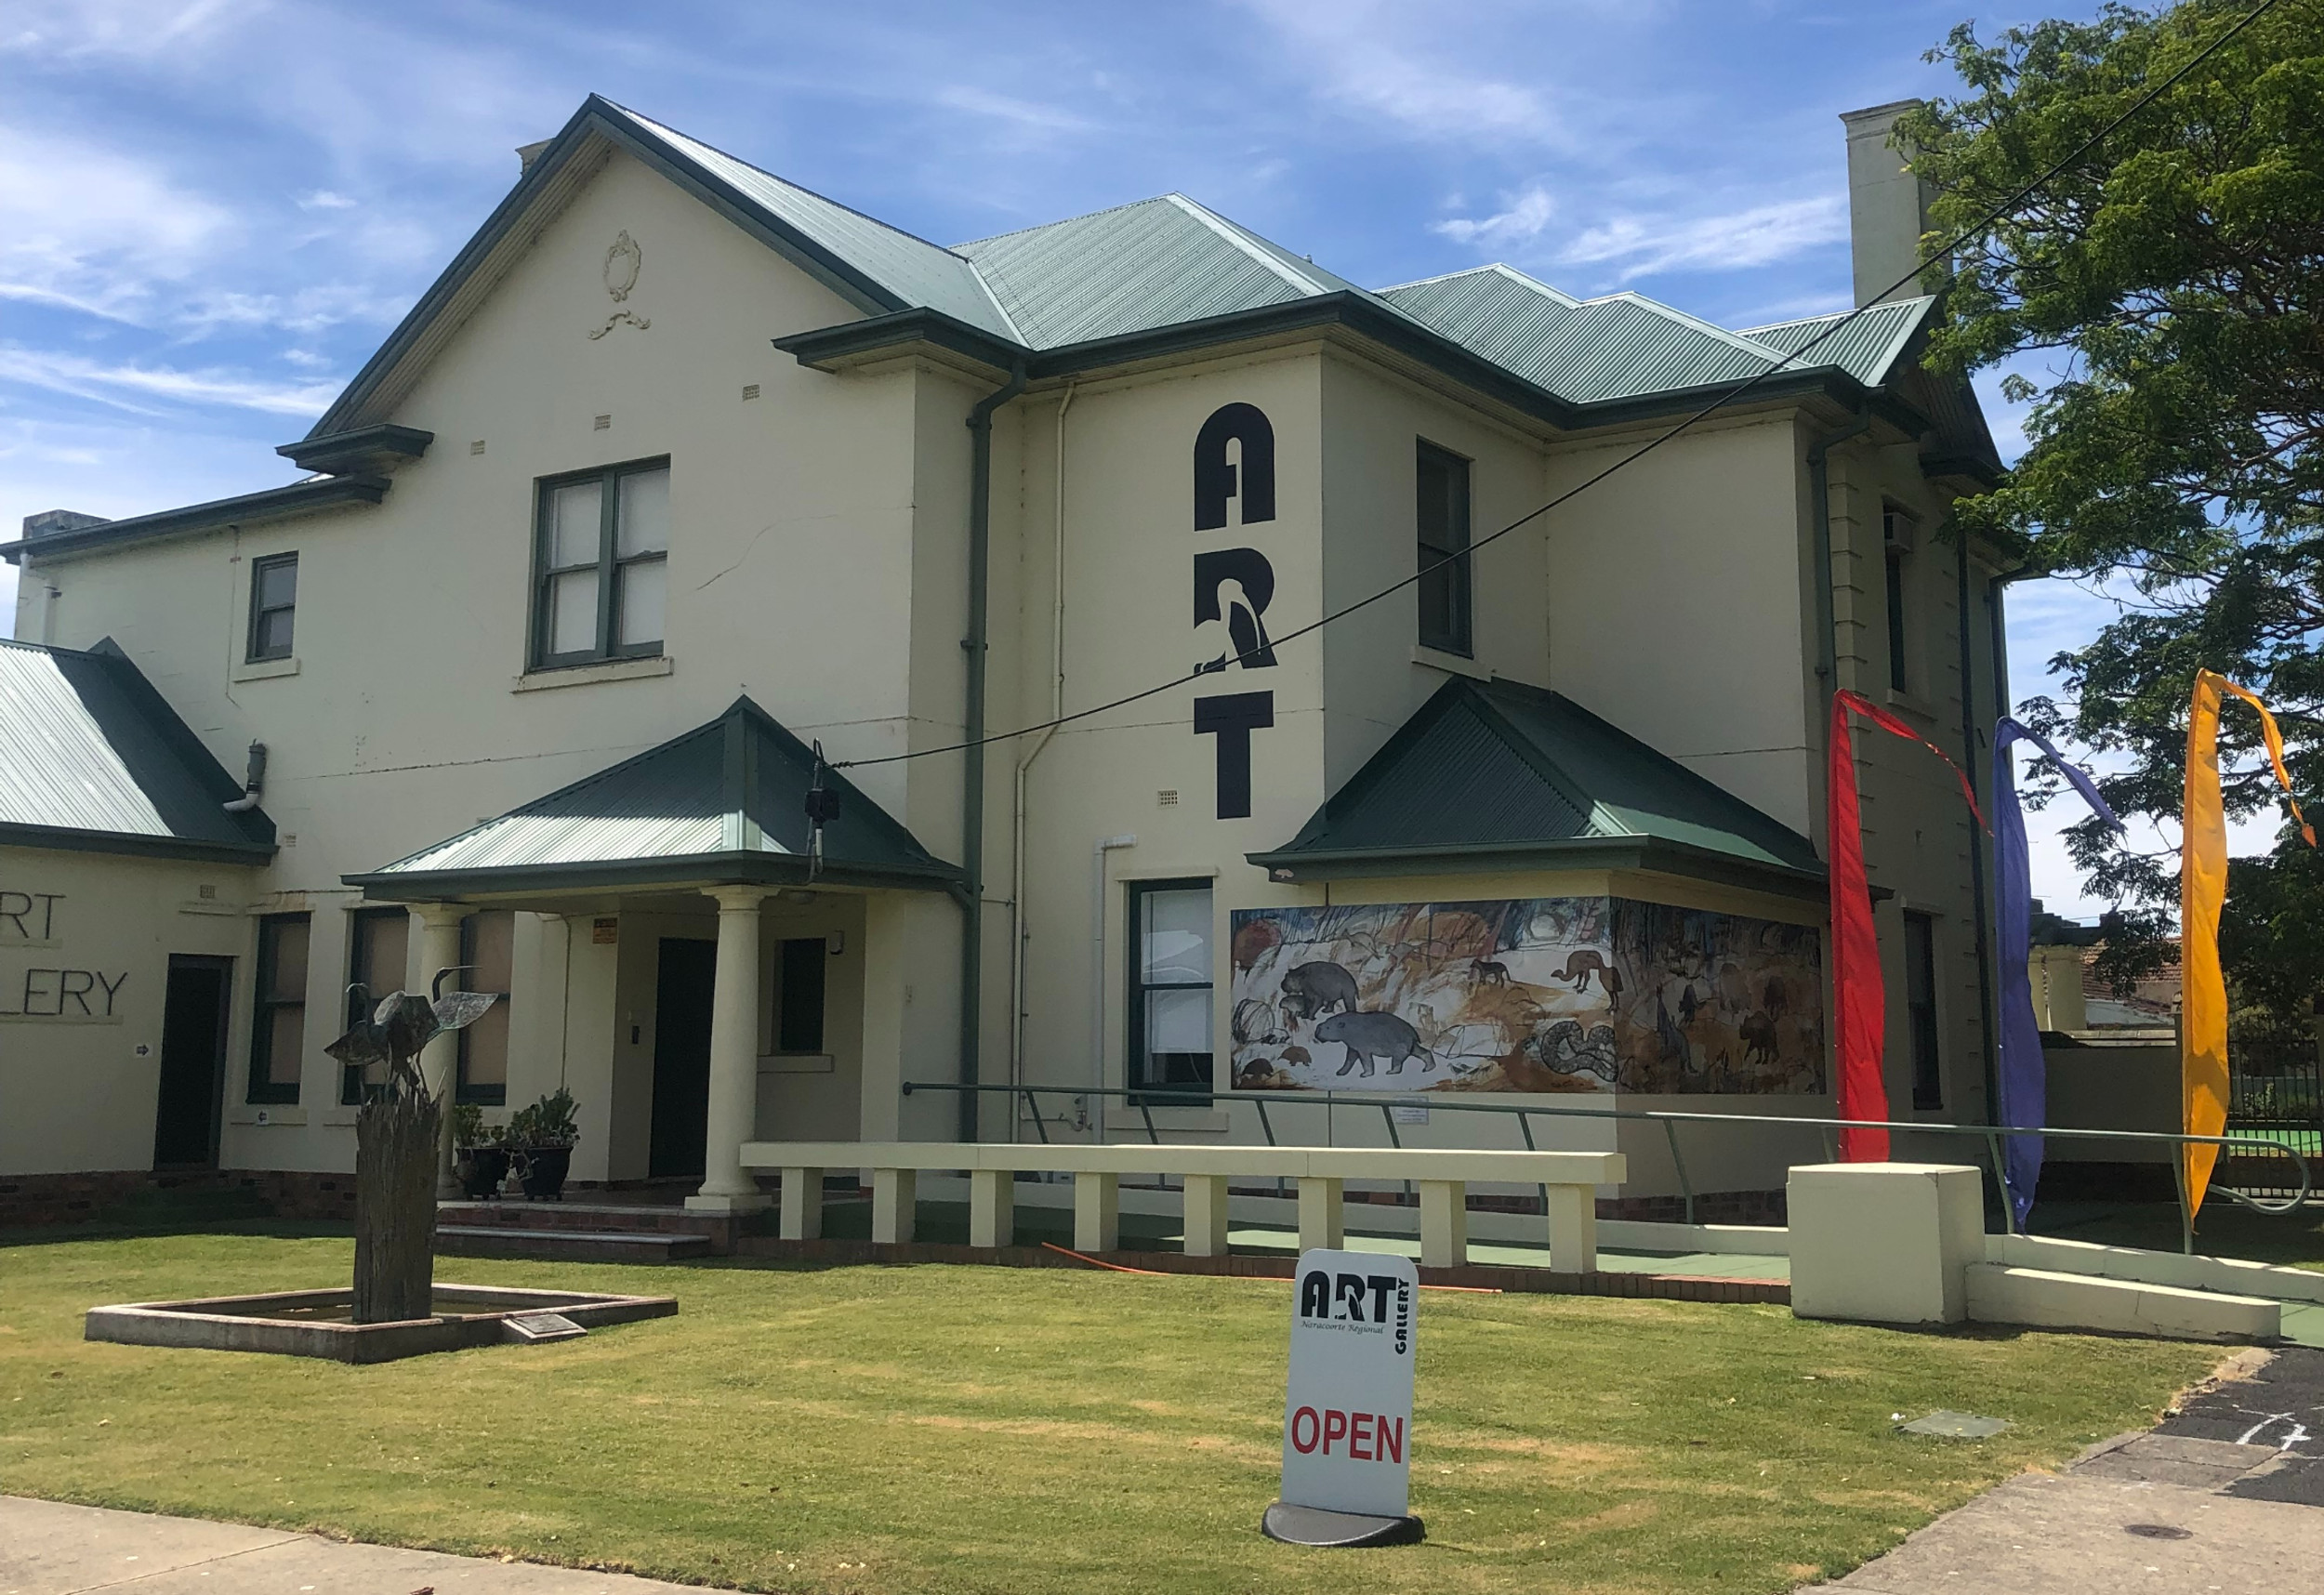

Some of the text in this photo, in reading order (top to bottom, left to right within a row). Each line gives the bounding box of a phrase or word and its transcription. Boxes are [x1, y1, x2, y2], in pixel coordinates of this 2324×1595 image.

[1194, 401, 1278, 820] ART
[0, 891, 67, 940] RT
[0, 969, 128, 1016] ERY
[1301, 1270, 1397, 1324] ART
[1394, 1277, 1410, 1355] GALLERY
[1301, 1320, 1384, 1335] Naracoorte Regional
[1291, 1405, 1403, 1464] OPEN
